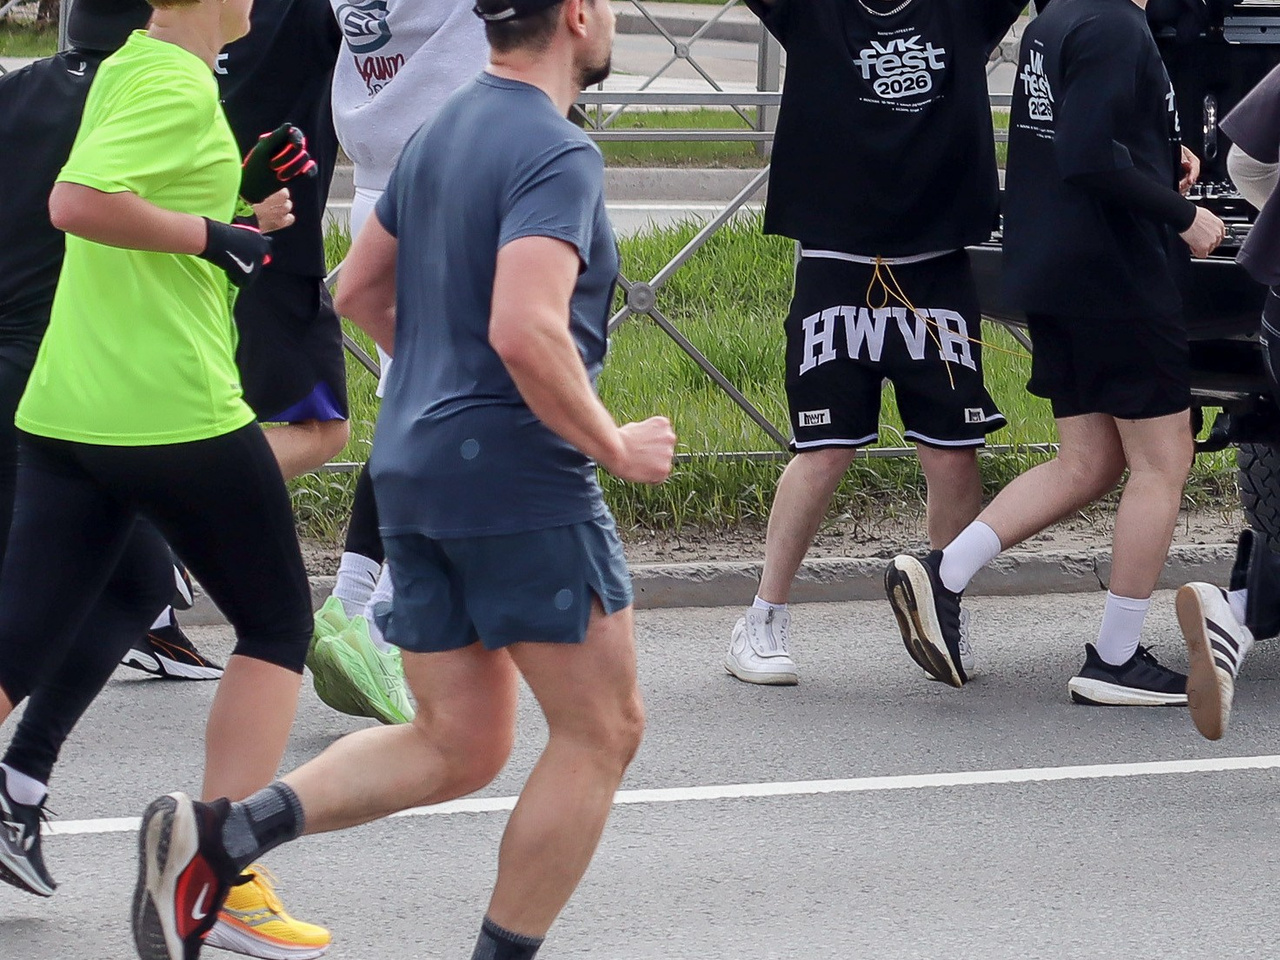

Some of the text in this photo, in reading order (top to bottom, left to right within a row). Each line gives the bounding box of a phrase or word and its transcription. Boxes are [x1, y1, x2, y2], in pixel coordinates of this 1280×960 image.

[853, 42, 946, 79] fest
[870, 34, 924, 54] VK
[876, 74, 929, 95] 2026
[1020, 64, 1055, 103] fest
[799, 305, 977, 376] HWVR
